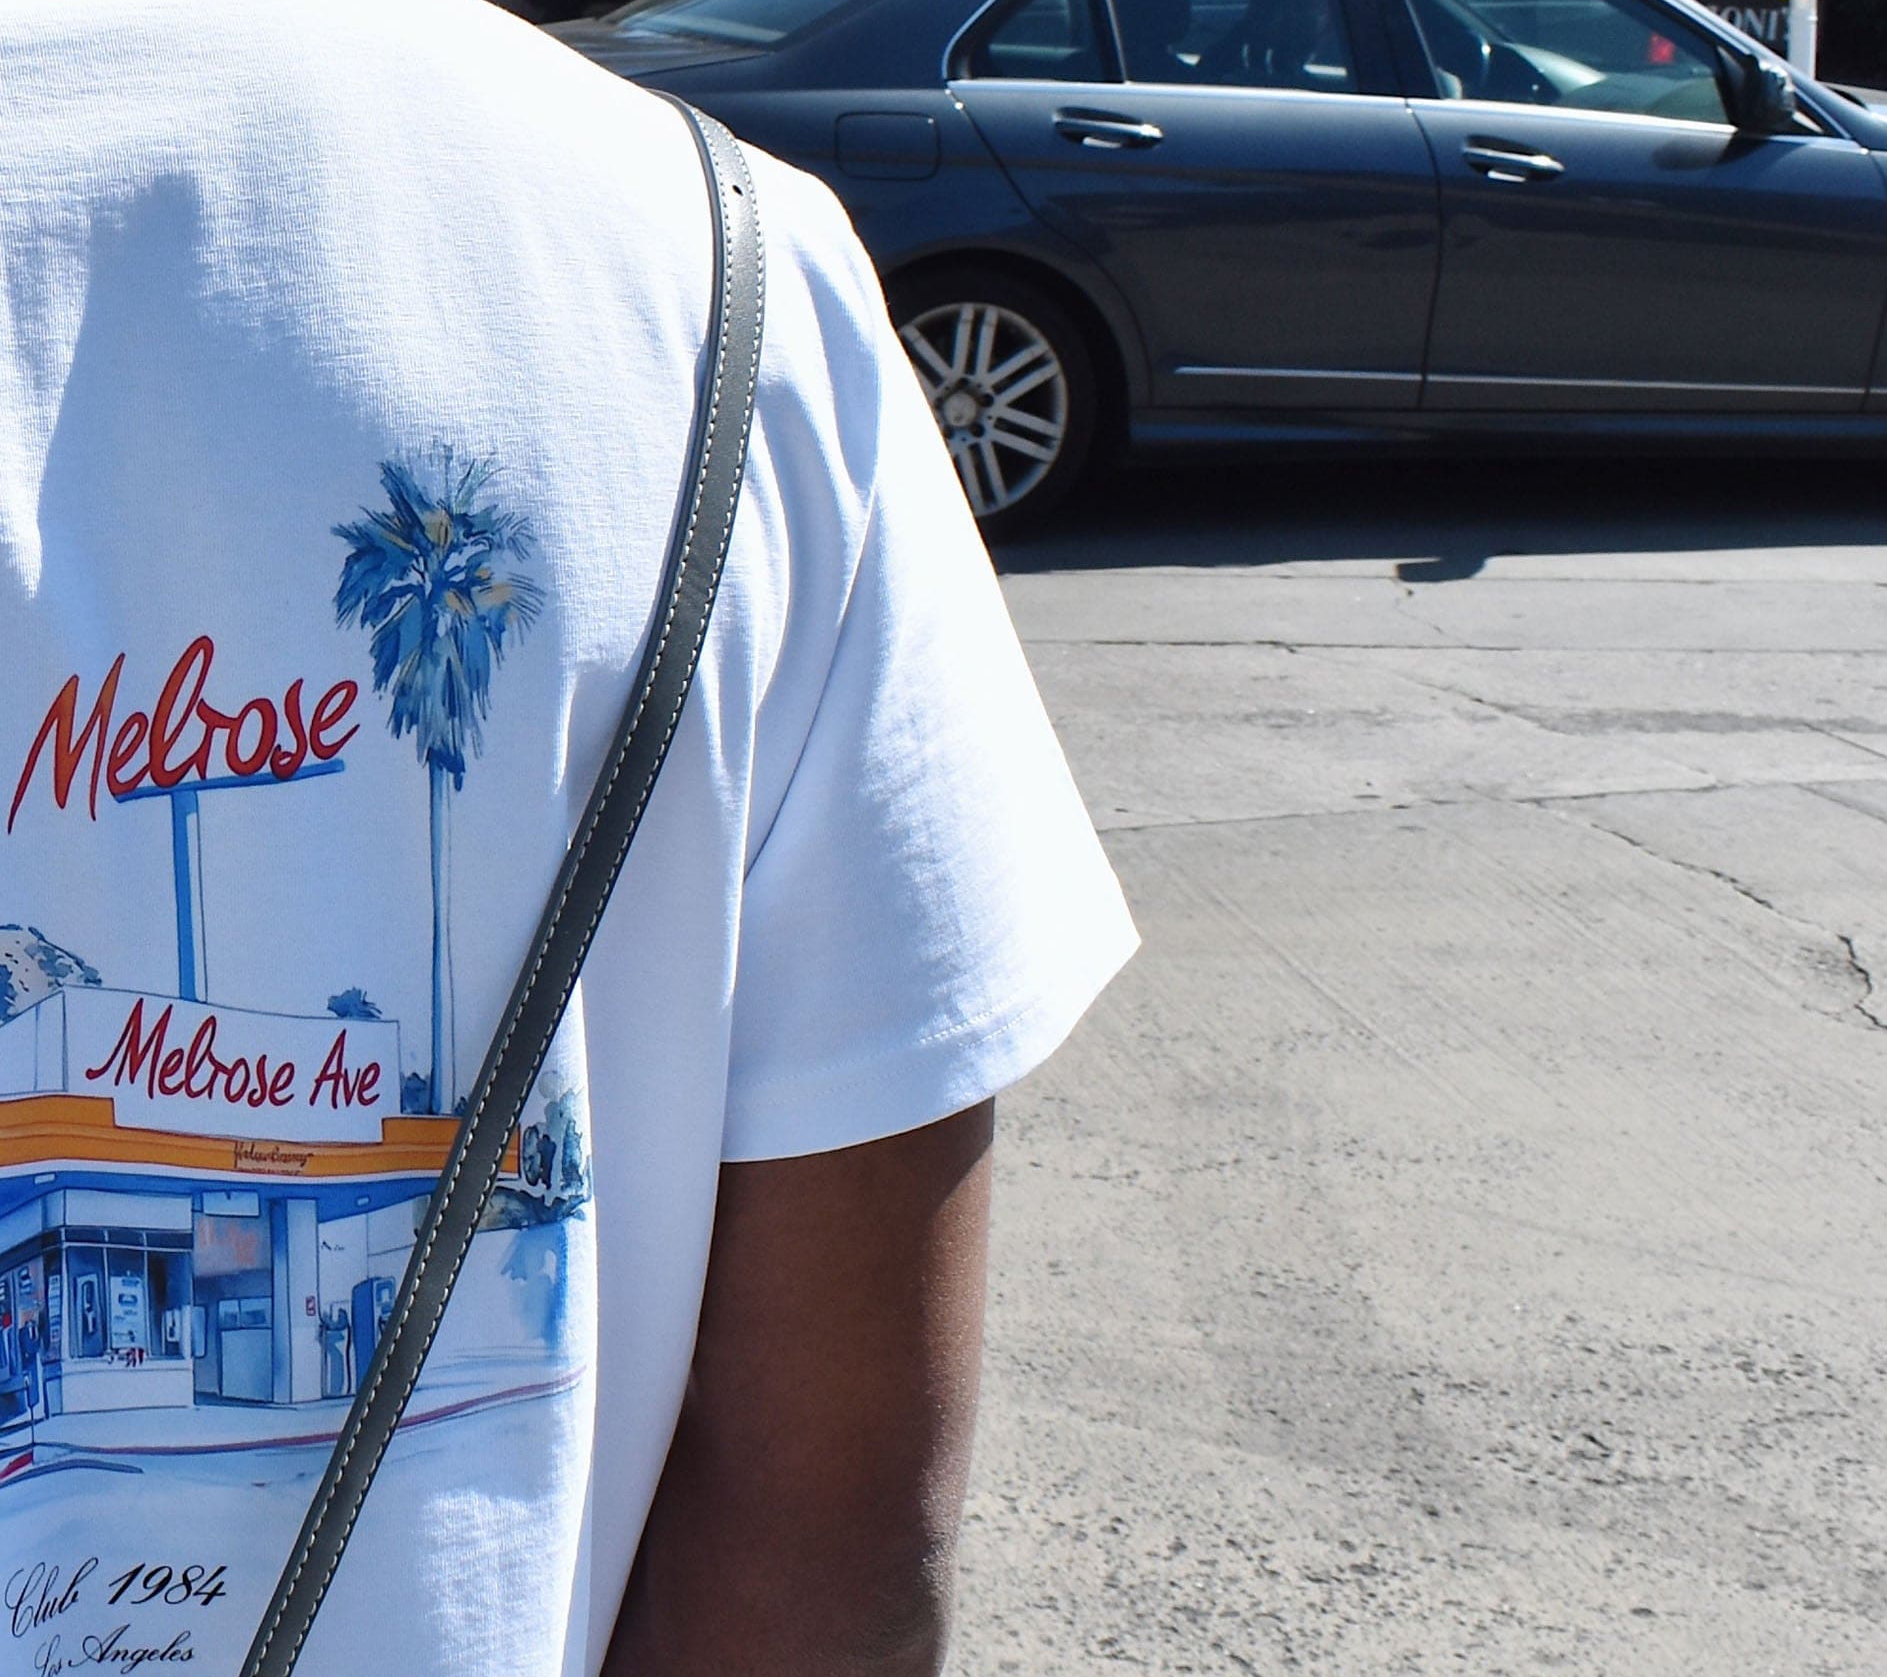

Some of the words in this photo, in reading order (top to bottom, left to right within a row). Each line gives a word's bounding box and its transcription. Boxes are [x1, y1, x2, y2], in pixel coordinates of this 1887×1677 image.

[7, 635, 361, 835] Melrose
[84, 997, 295, 1108] Melrose
[309, 1028, 381, 1109] Ave
[4, 1556, 99, 1638] Club
[107, 1562, 228, 1606] 1984
[68, 1624, 194, 1675] Angeles
